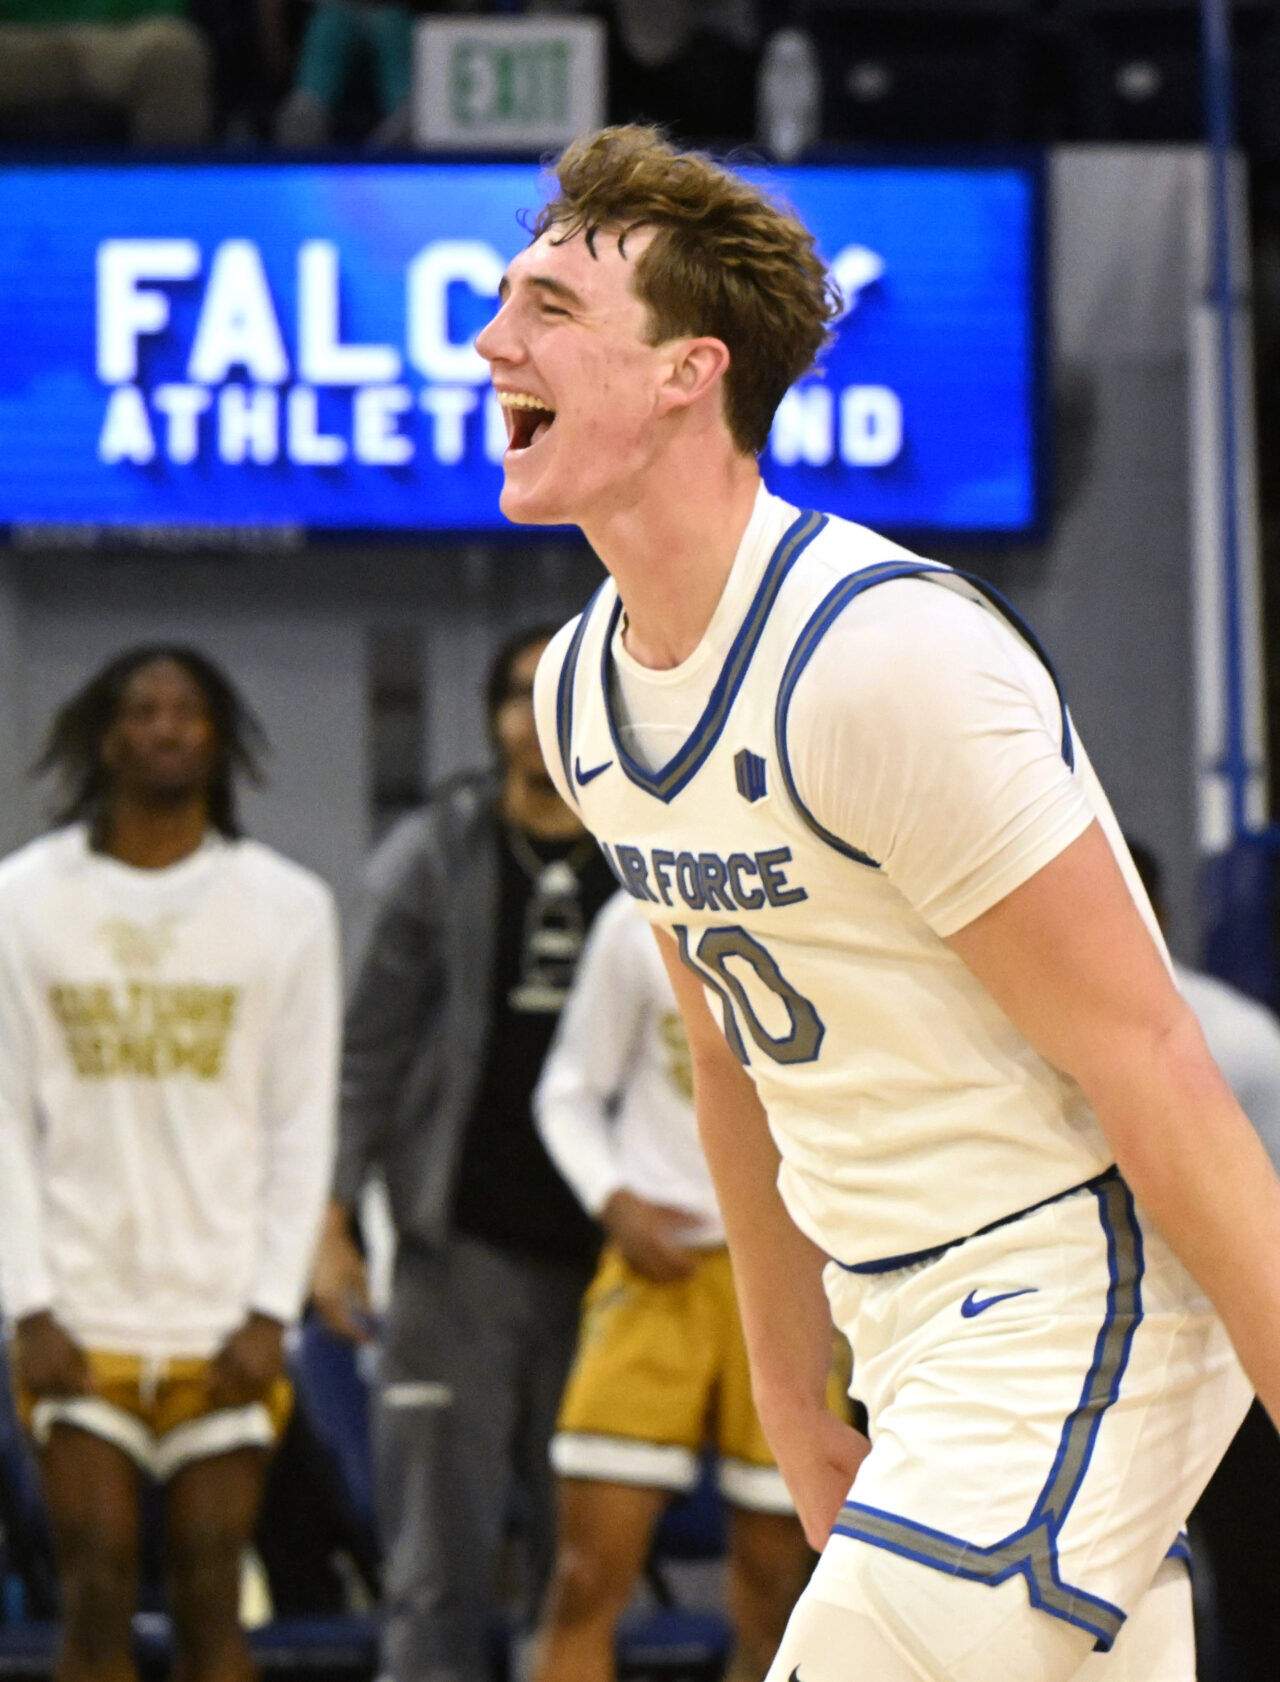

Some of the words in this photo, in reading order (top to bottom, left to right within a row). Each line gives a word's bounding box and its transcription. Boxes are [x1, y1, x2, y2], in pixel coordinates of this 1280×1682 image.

[453, 40, 571, 127] EXIT
[97, 238, 503, 385] FALC
[101, 383, 507, 466] ATHLETI
[601, 841, 660, 904] IR
[651, 846, 809, 912] FORCE
